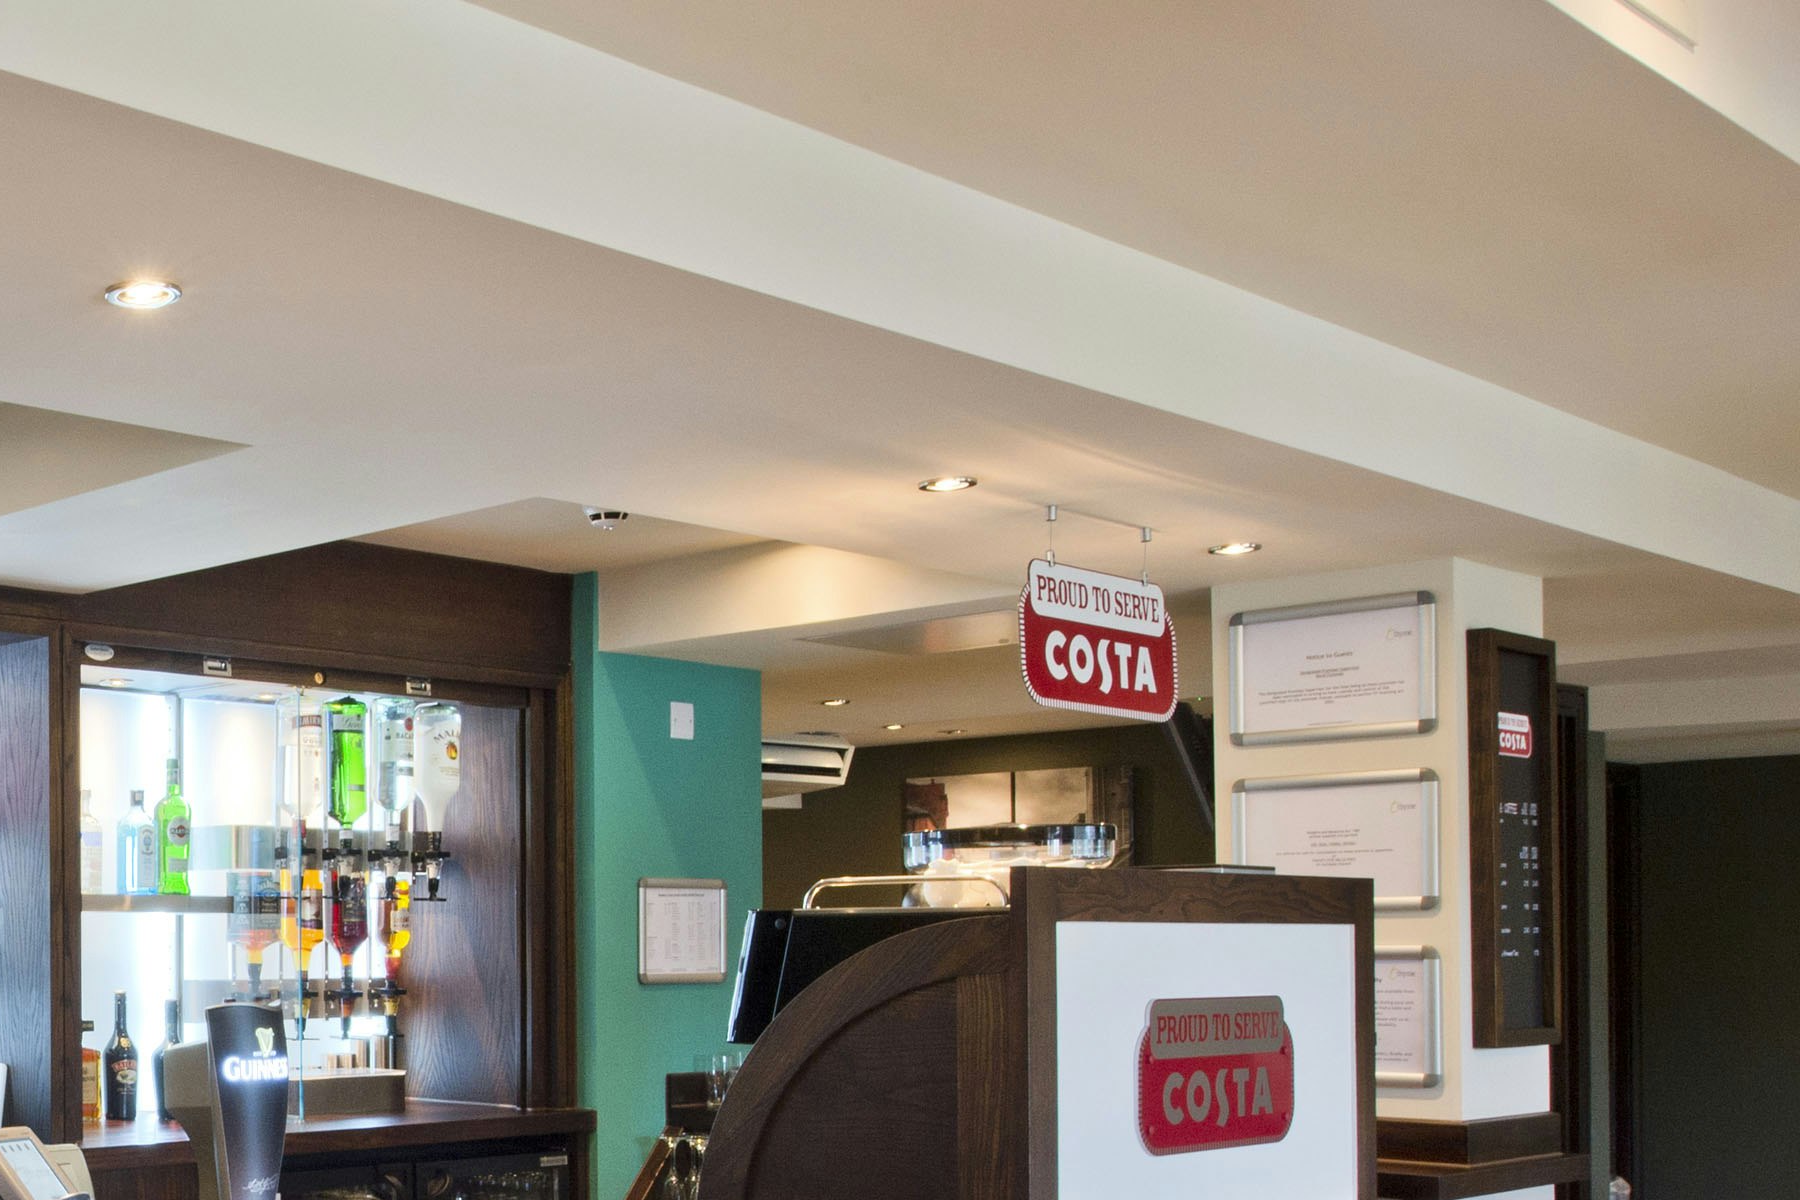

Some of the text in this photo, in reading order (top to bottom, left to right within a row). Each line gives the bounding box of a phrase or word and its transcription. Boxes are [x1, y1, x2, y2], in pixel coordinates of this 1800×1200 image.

[1037, 575, 1159, 623] PROUD TO SERVE
[1045, 630, 1157, 694] COSTA
[1499, 732, 1527, 750] COSTA
[1156, 1011, 1279, 1044] PROUD TO SERVE
[1163, 1066, 1273, 1127] COSTA
